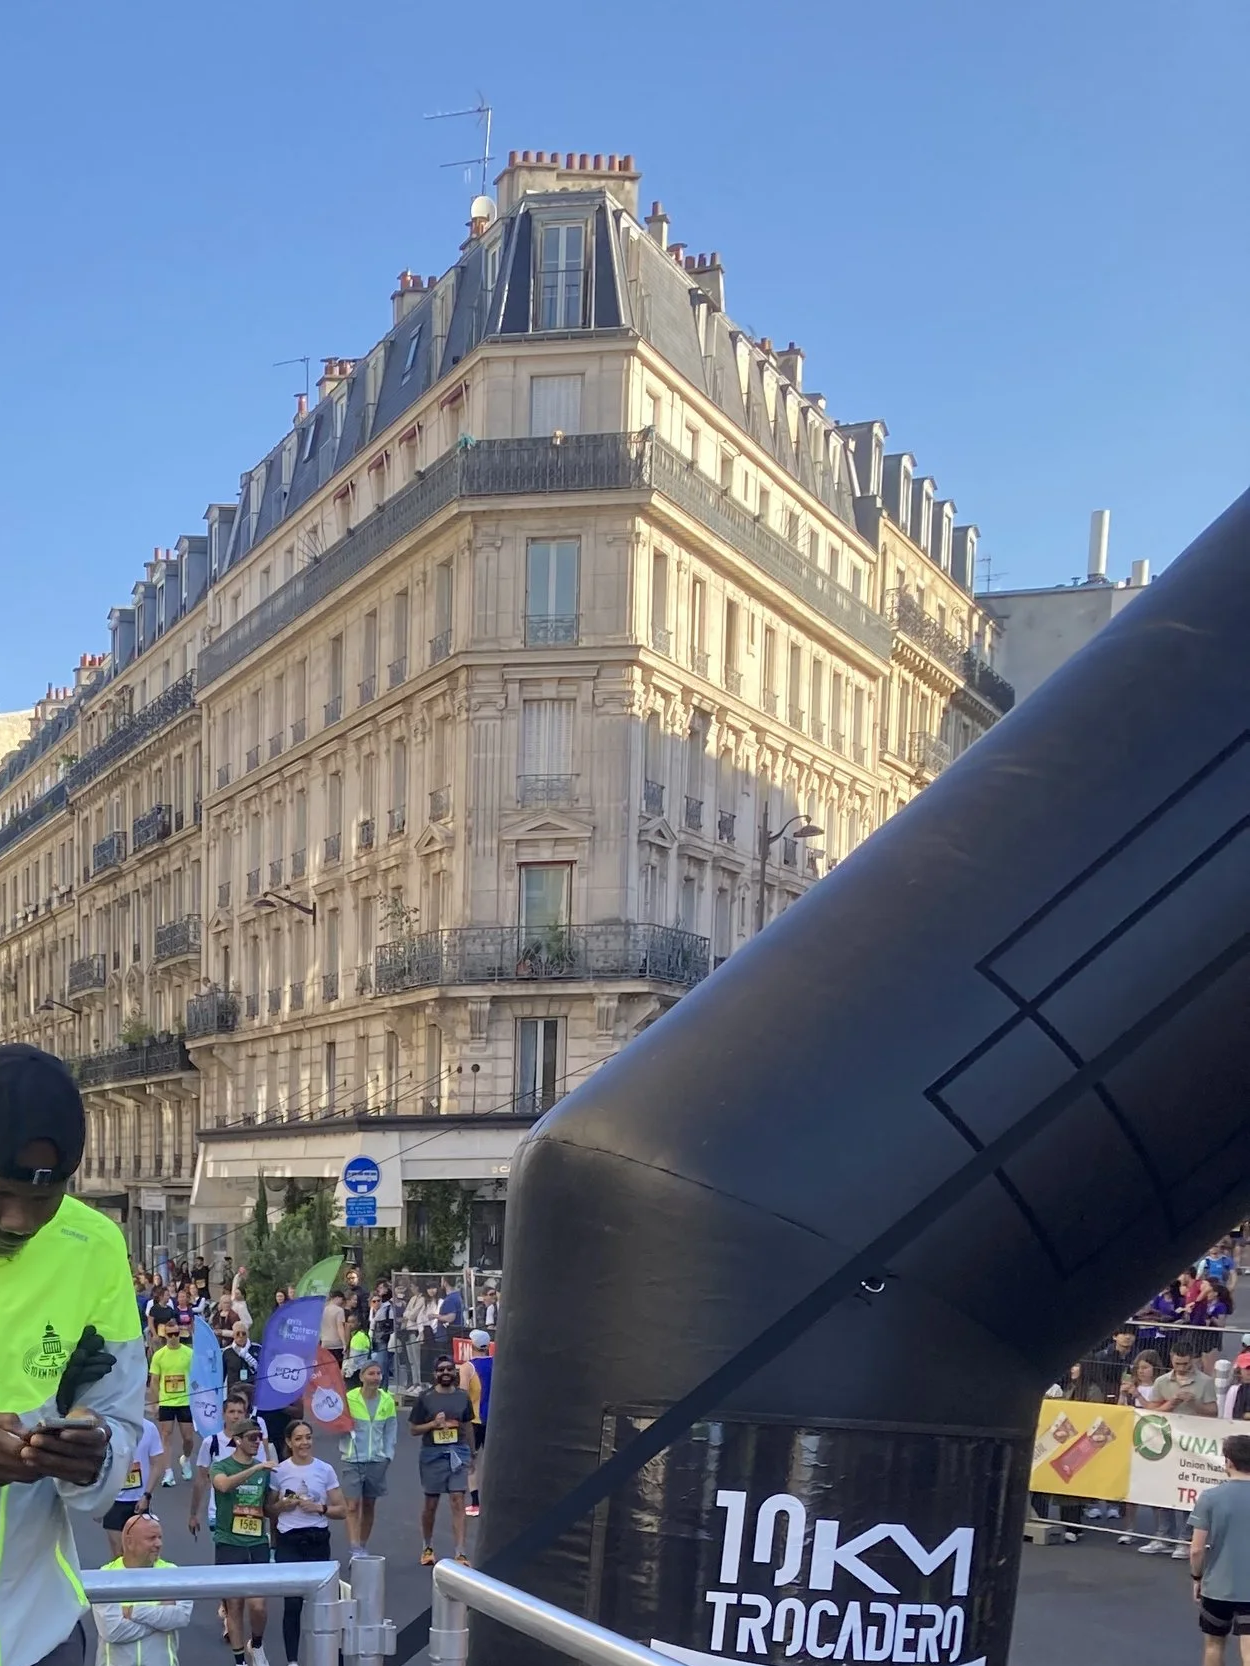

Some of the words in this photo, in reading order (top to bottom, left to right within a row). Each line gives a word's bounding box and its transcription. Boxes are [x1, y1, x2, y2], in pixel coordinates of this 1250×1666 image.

[1179, 1435, 1223, 1456] UNA
[1180, 1459, 1205, 1470] Union
[1178, 1472, 1190, 1481] de
[706, 1591, 965, 1663] TROCADERO
